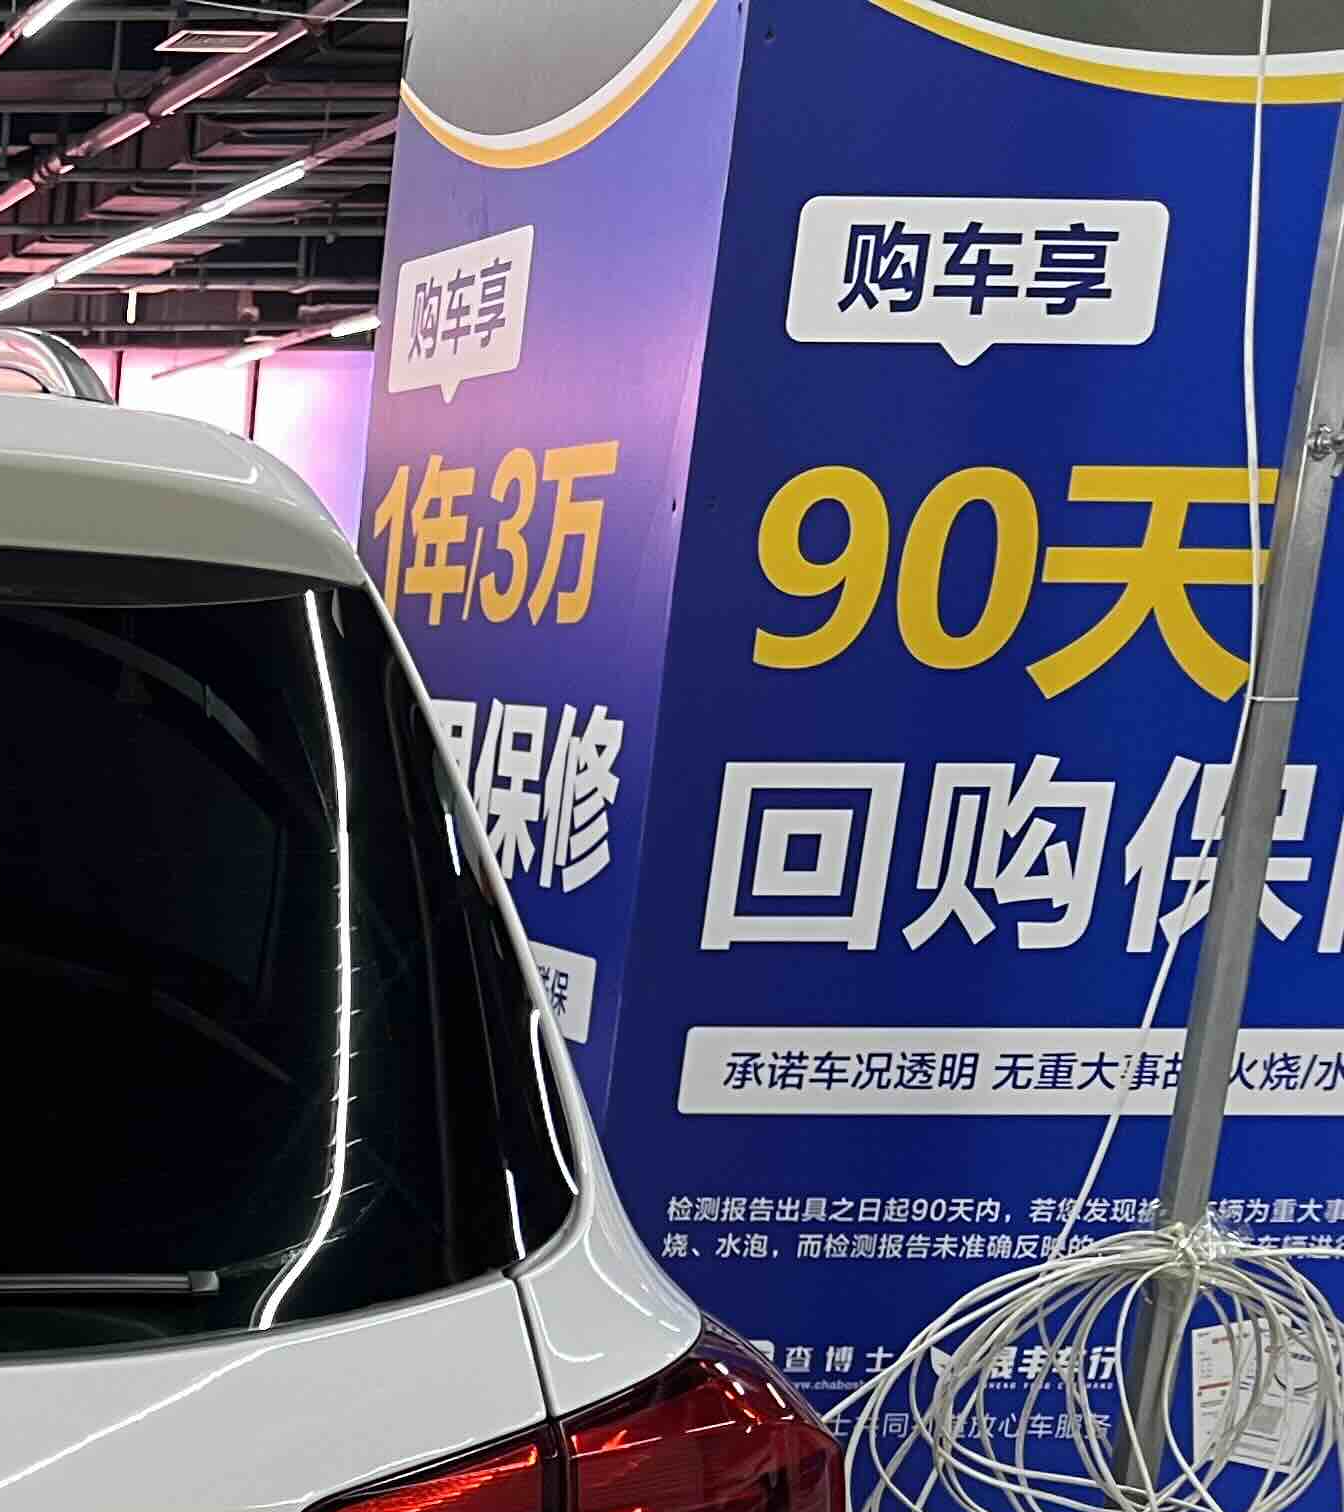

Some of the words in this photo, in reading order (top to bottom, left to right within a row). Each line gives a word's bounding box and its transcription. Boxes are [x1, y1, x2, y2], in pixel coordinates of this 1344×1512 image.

[408, 257, 512, 363] 购车享
[838, 221, 1119, 315] 购车享
[752, 464, 1280, 702] 90天
[700, 753, 1344, 953] 回购保
[723, 1050, 980, 1091] 承诺车况透明
